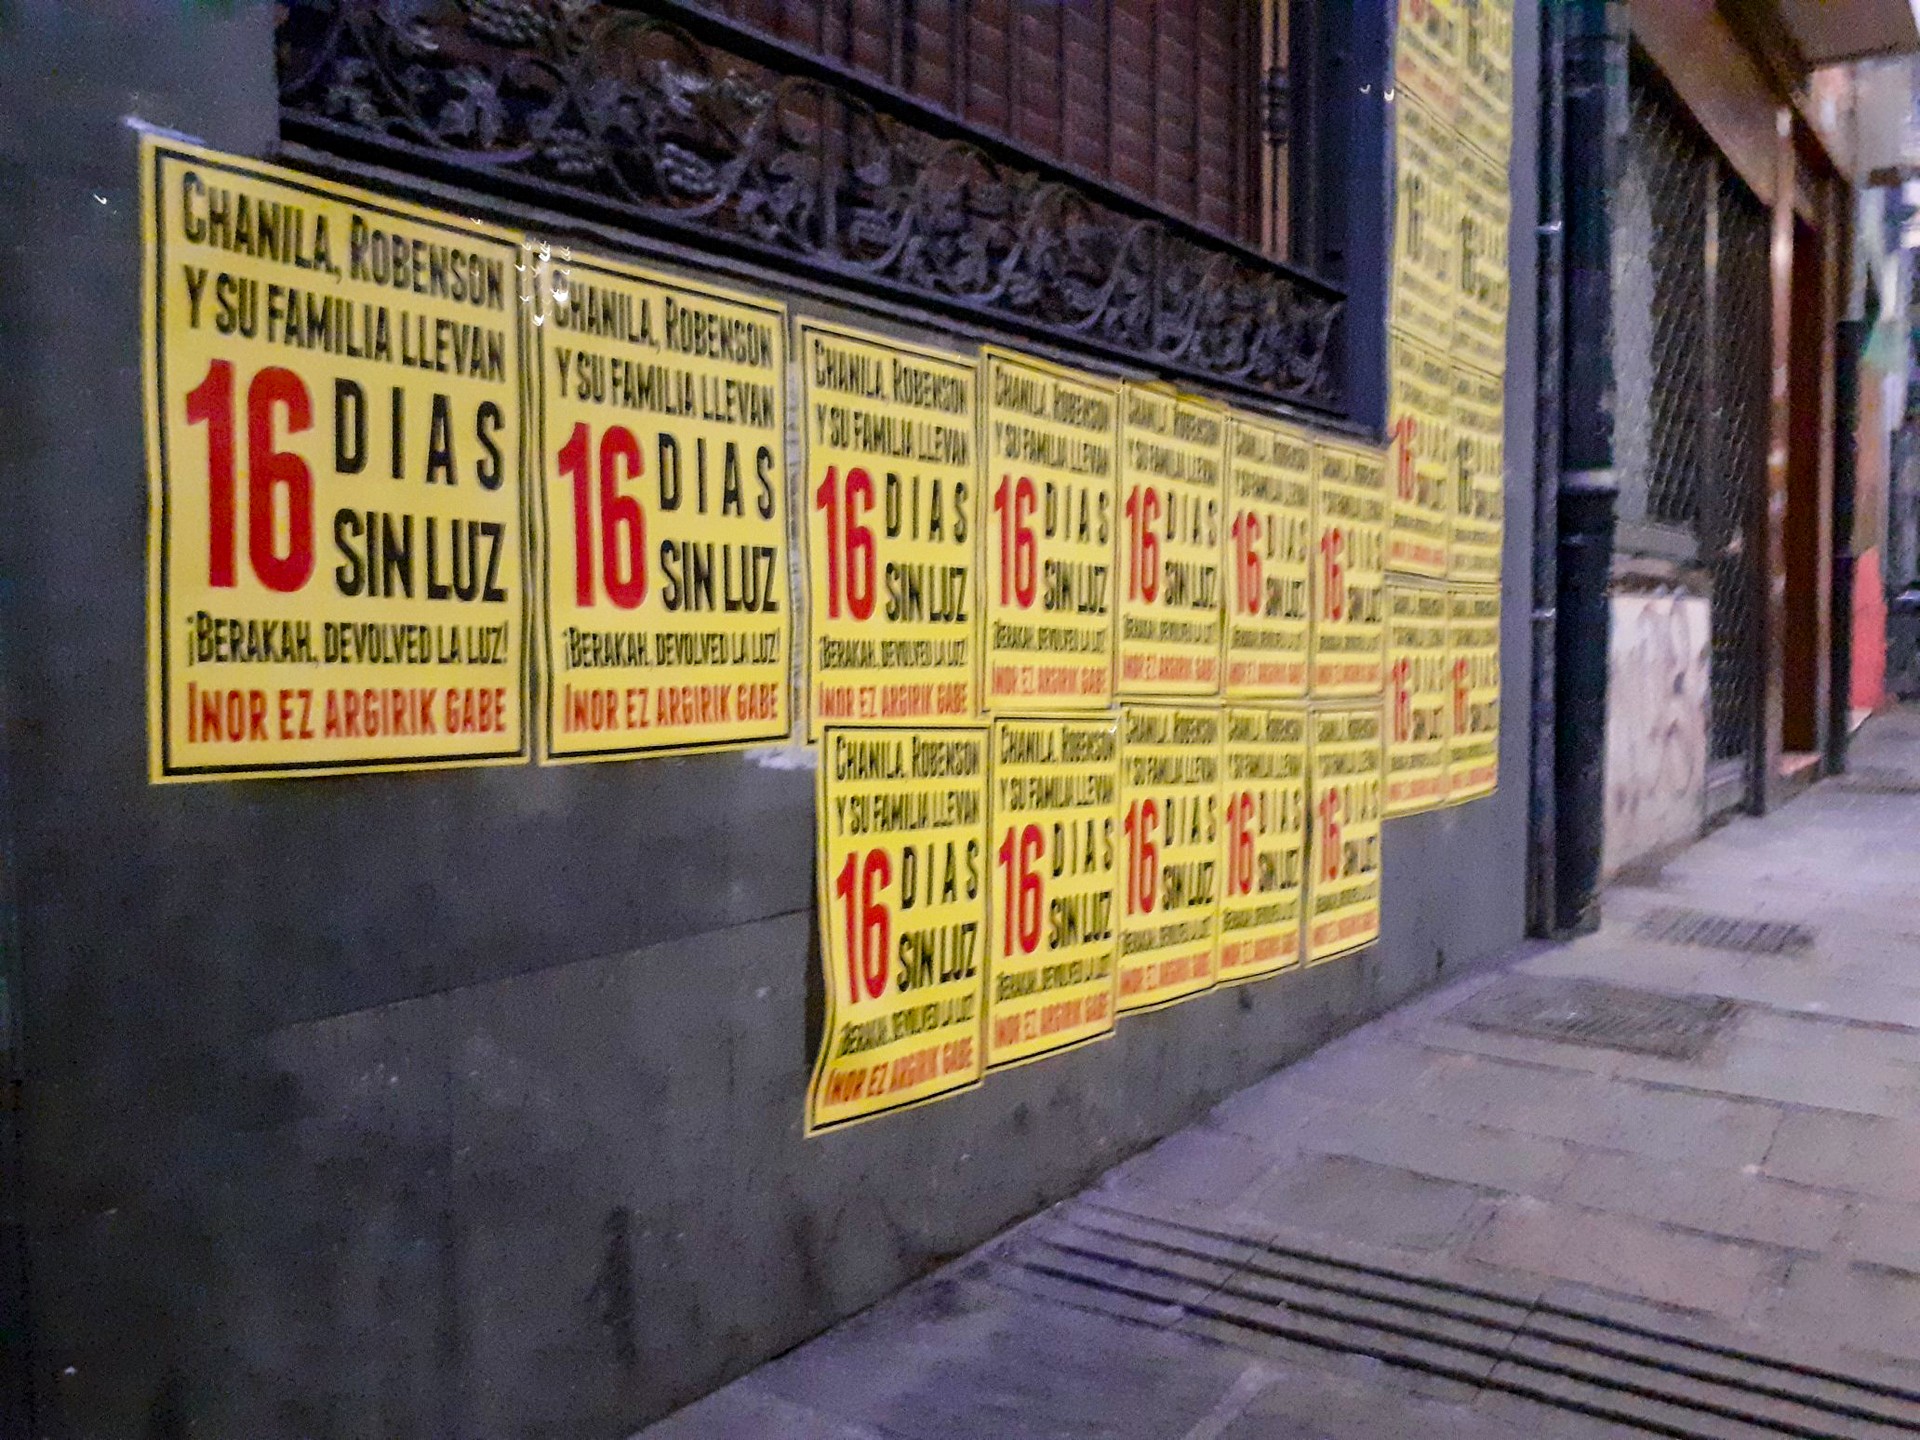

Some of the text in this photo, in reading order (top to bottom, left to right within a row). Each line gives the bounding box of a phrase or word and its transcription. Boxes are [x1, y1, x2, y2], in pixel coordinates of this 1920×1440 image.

[182, 171, 503, 310] CHANILA, ROBENSON
[183, 265, 504, 381] Y SU FAMILIA LLEVAN
[552, 270, 772, 367] CHANILA, ROBENSON
[334, 378, 504, 491] DIAS
[555, 347, 774, 428] Y SU FAMILIA LLEVAN
[816, 403, 968, 466] Y SU FAMILIA LLEVAN
[186, 359, 314, 592] 16
[558, 422, 647, 609] 16
[658, 433, 774, 520] DIAS
[885, 473, 968, 544] DIAS
[334, 508, 507, 603] SIN LUZ
[660, 540, 778, 613] SIN LUZ
[816, 465, 876, 621] 16
[994, 475, 1037, 609] 16
[1125, 485, 1161, 604] 16
[885, 562, 967, 623] SIN LUZ
[324, 622, 431, 664] DEVOLVED
[438, 626, 462, 664] LA
[467, 622, 508, 665] LUZ!
[656, 633, 728, 666] DEVOLVED
[732, 633, 749, 665] LA
[752, 628, 780, 665] LUZ!
[188, 682, 505, 743] INOR EZ ARGIRIK GABE
[564, 684, 777, 732] INOR EZ ARGIRIK GABE
[901, 839, 978, 910] DIAS
[999, 824, 1045, 957] 16
[1124, 799, 1158, 915] 16
[837, 849, 892, 1004] 16
[897, 930, 934, 992] SIN
[939, 922, 977, 984] LUZ
